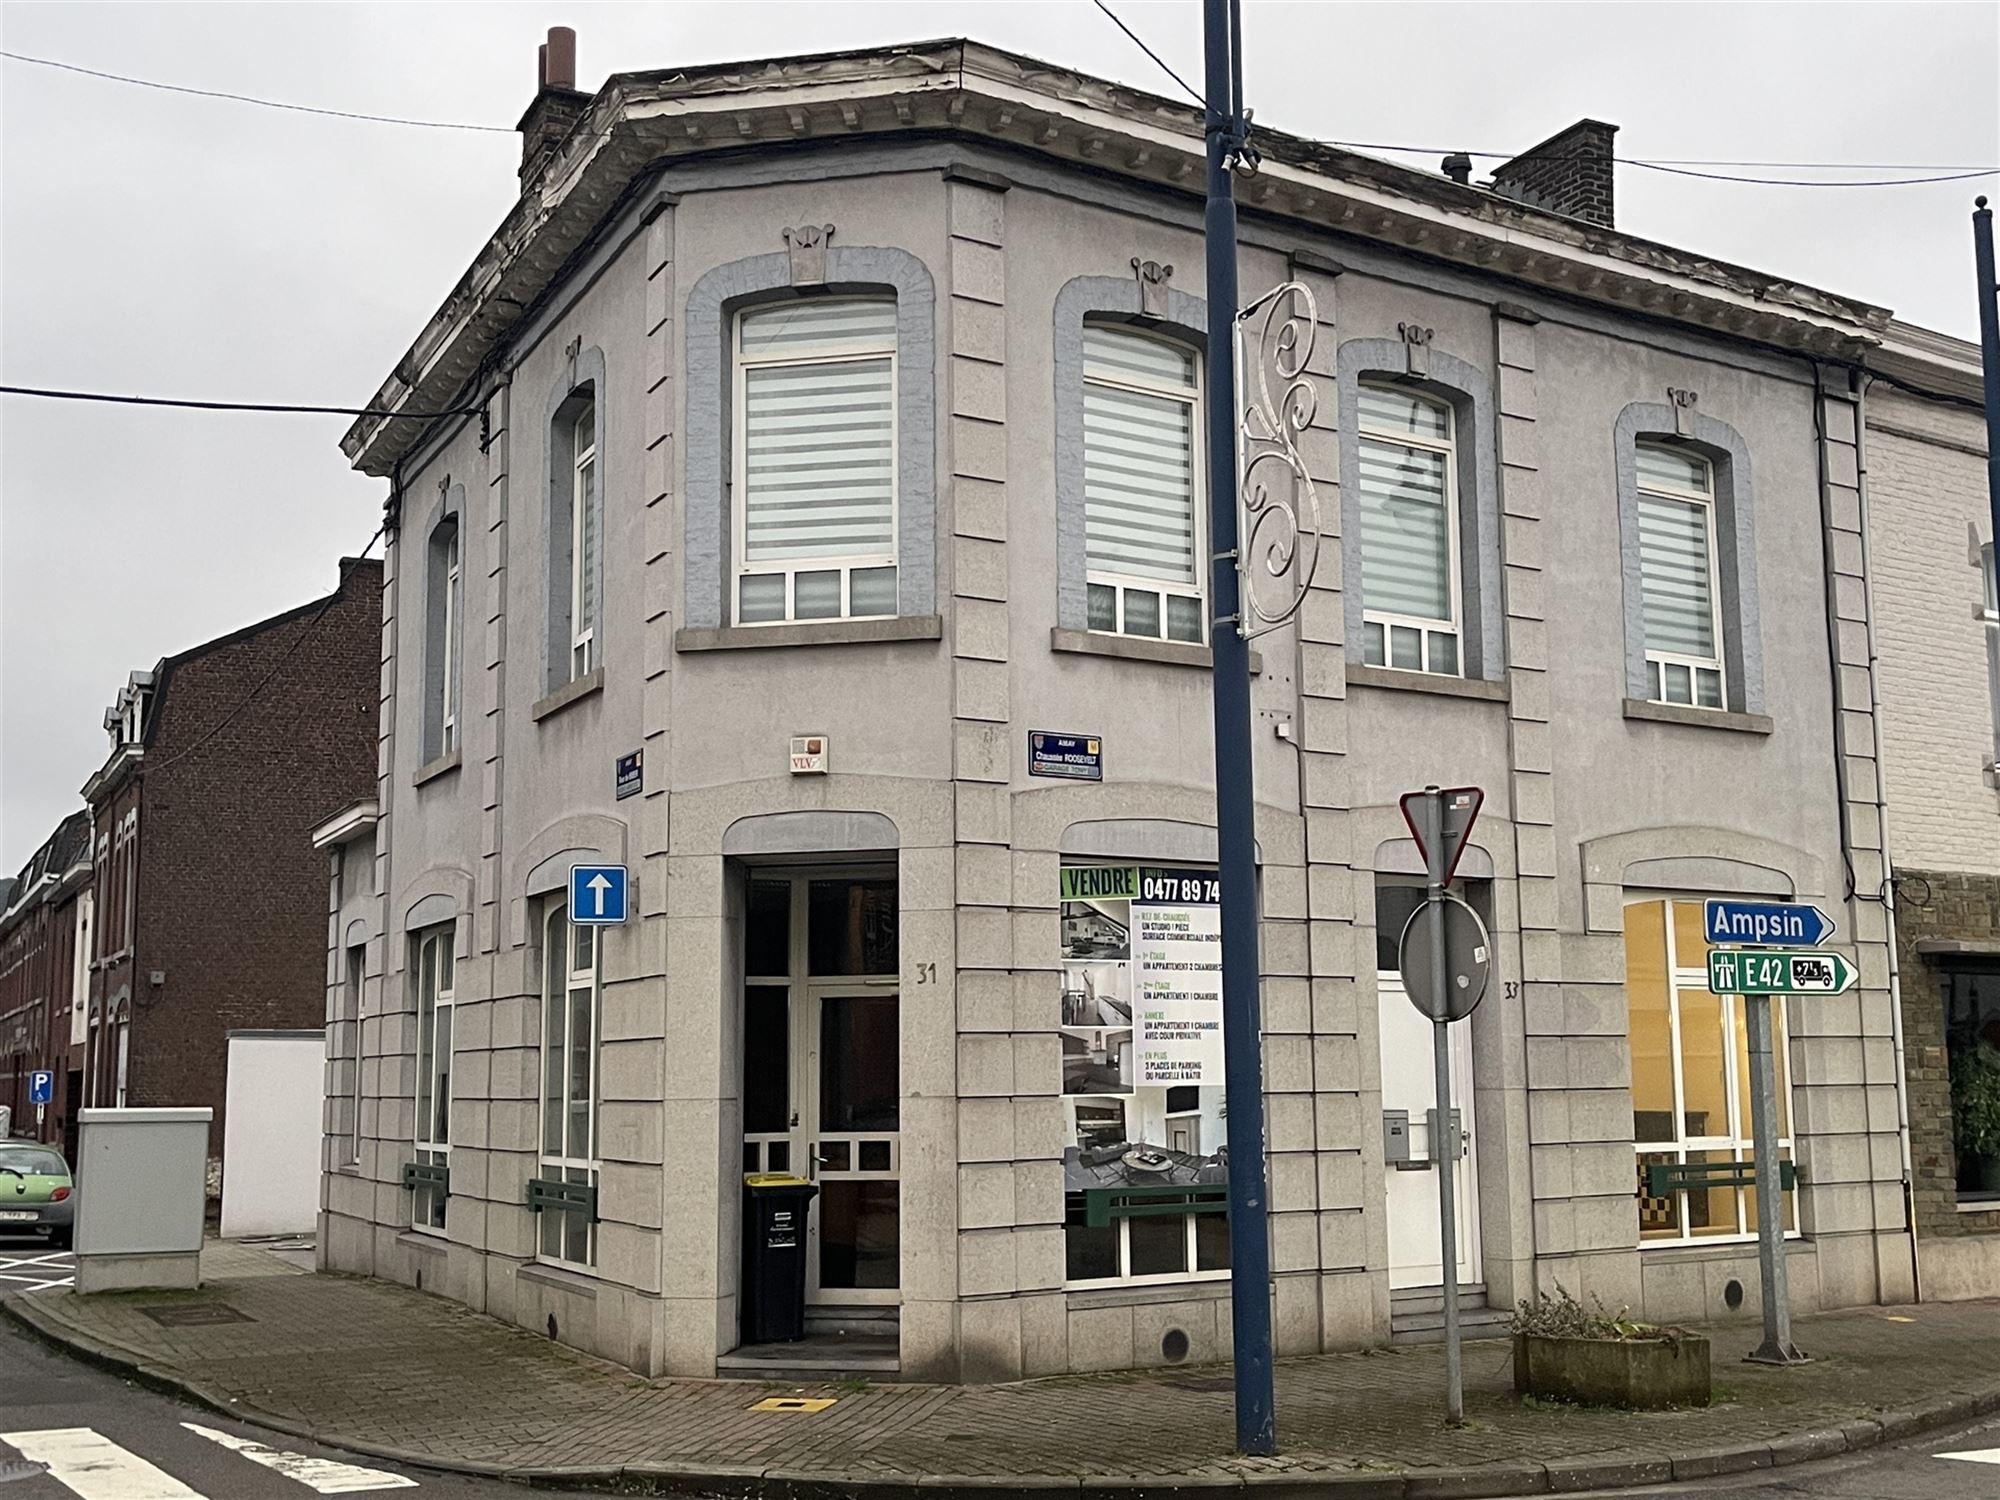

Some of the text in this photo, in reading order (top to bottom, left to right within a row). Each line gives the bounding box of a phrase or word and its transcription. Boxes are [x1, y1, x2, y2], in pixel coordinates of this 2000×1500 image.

[1069, 868, 1134, 896] VENDRE
[1144, 877, 1220, 902] 0477 89 74
[1142, 922, 1150, 930] UN
[1714, 905, 1803, 942] Ampsin
[1142, 932, 1166, 940] SURFACE
[1143, 962, 1151, 970] UN
[1152, 962, 1189, 971] APPARTEMENT
[916, 962, 936, 984] 31
[1504, 981, 1519, 1000] 33
[1143, 992, 1152, 1000] UN
[1153, 992, 1189, 1000] APPARTEMENT
[1144, 1021, 1153, 1030] UN
[1153, 1021, 1190, 1030] APPARTEMENT
[1144, 1031, 1159, 1040] AVEC
[1159, 1031, 1175, 1040] COUR
[1150, 1062, 1170, 1070] PLACES
[1178, 1062, 1202, 1070] PARKING
[1154, 1071, 1180, 1080] PARCELLE
[34, 1073, 48, 1091] P
